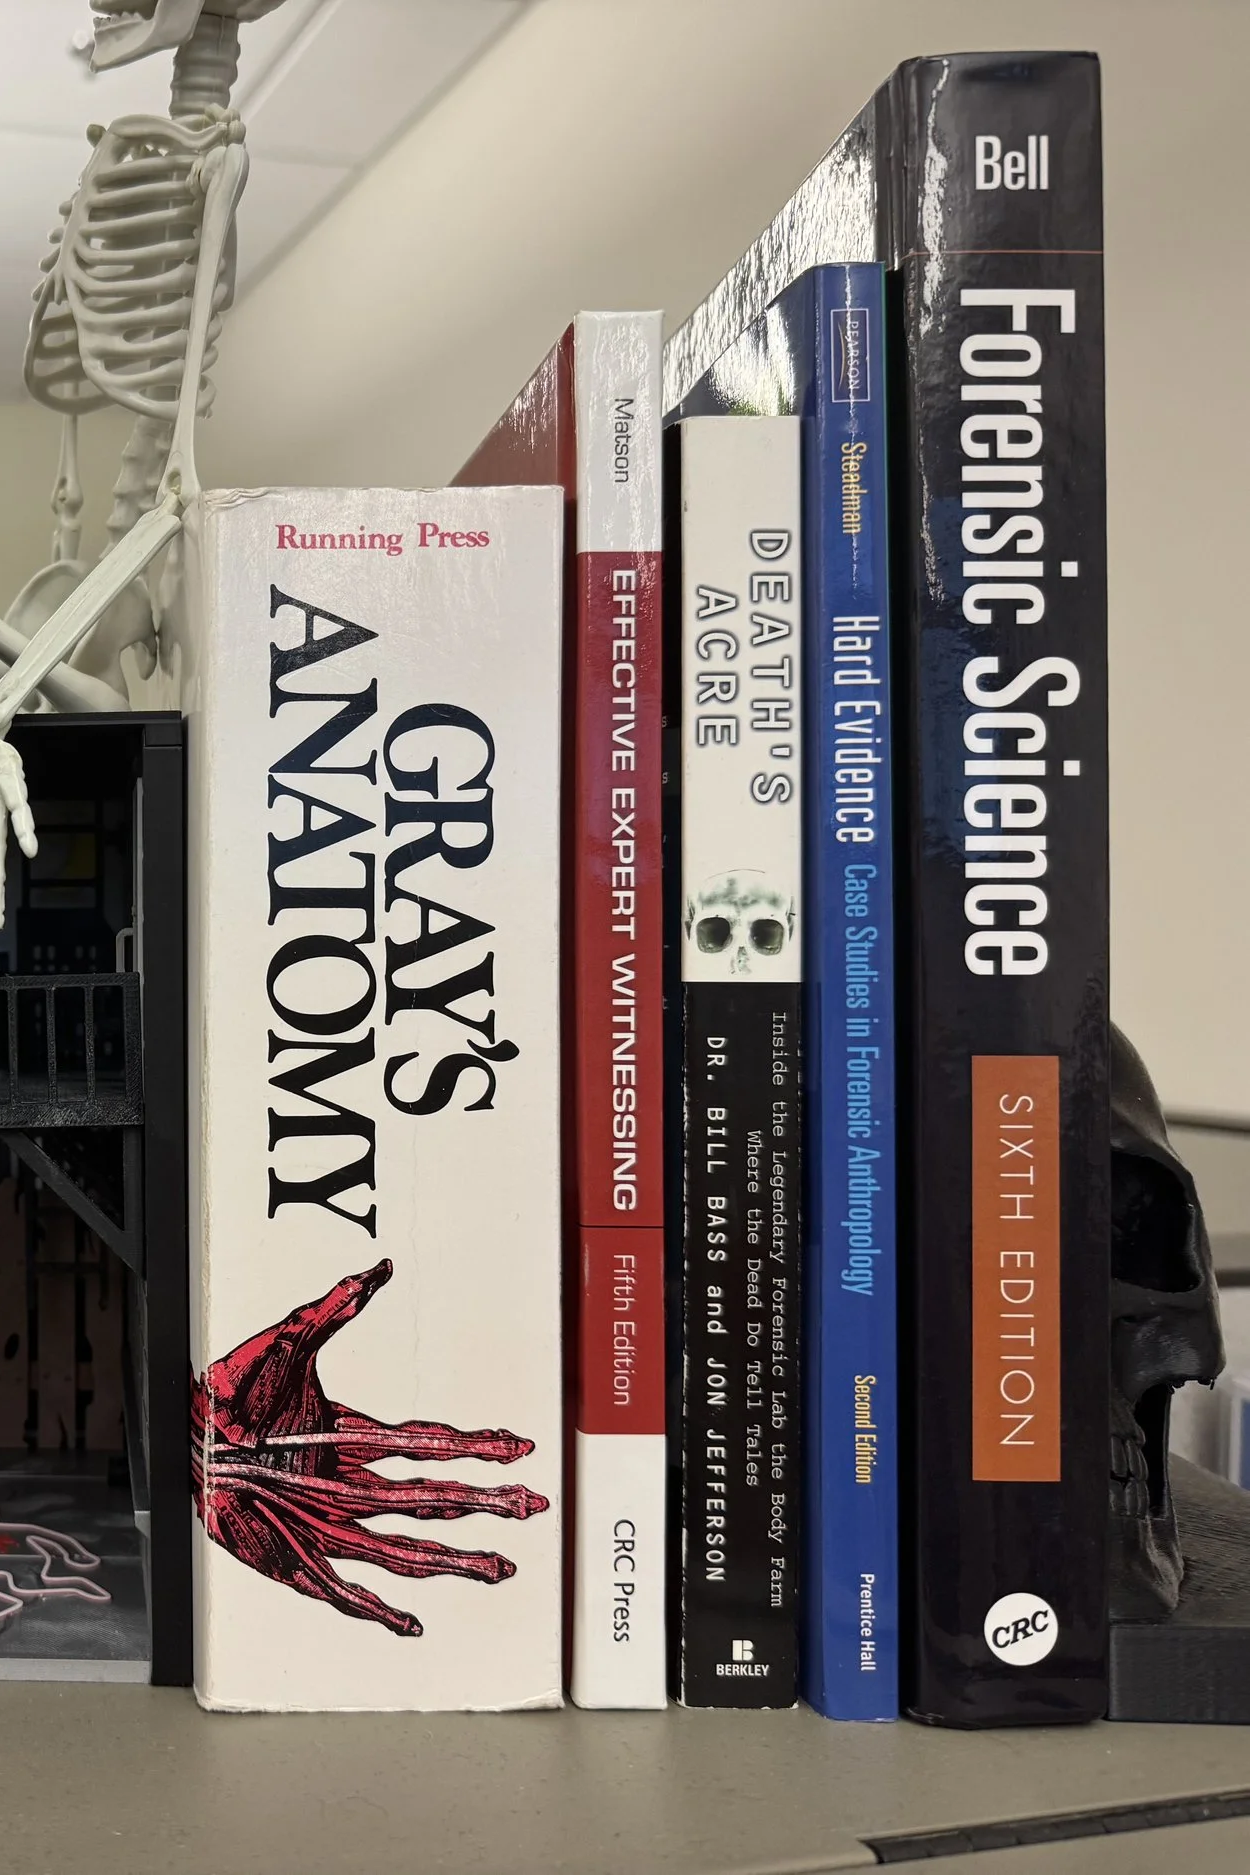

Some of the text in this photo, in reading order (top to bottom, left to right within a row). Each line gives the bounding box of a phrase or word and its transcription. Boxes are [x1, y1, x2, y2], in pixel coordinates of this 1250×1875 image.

[974, 134, 1049, 190] Bell
[847, 321, 860, 390] PEARSON
[615, 398, 635, 484] Matson
[841, 441, 867, 535] Steadman
[275, 521, 490, 556] Running Press
[696, 585, 738, 746] ACRE
[750, 530, 792, 804] DEATH'S
[959, 288, 1082, 976] Forensic Science
[832, 616, 883, 844] Hard Evidence
[266, 583, 379, 1240] ANATOMY
[382, 702, 519, 1116] GRAY'S
[611, 569, 637, 1211] EFFECTIVE EXPERT WITNESSING
[841, 864, 882, 1297] Case Studies in Forensic Anthropology
[613, 1254, 636, 1406] Fifth Edition
[705, 1036, 728, 1581] DR. BILL BASS and JON JEFFERSON
[746, 1130, 763, 1487] Where the Dead Do Tell Tales
[768, 1012, 789, 1607] Inside the Legendary Forensic Lab the Body Farm
[999, 1093, 1036, 1446] SIXTH EDITION
[853, 1374, 878, 1485] Second Edition
[613, 1519, 636, 1643] CRC Press
[860, 1573, 876, 1672] Prentice Hall
[991, 1609, 1052, 1649] CRC
[715, 1663, 770, 1677] BERKLEY
